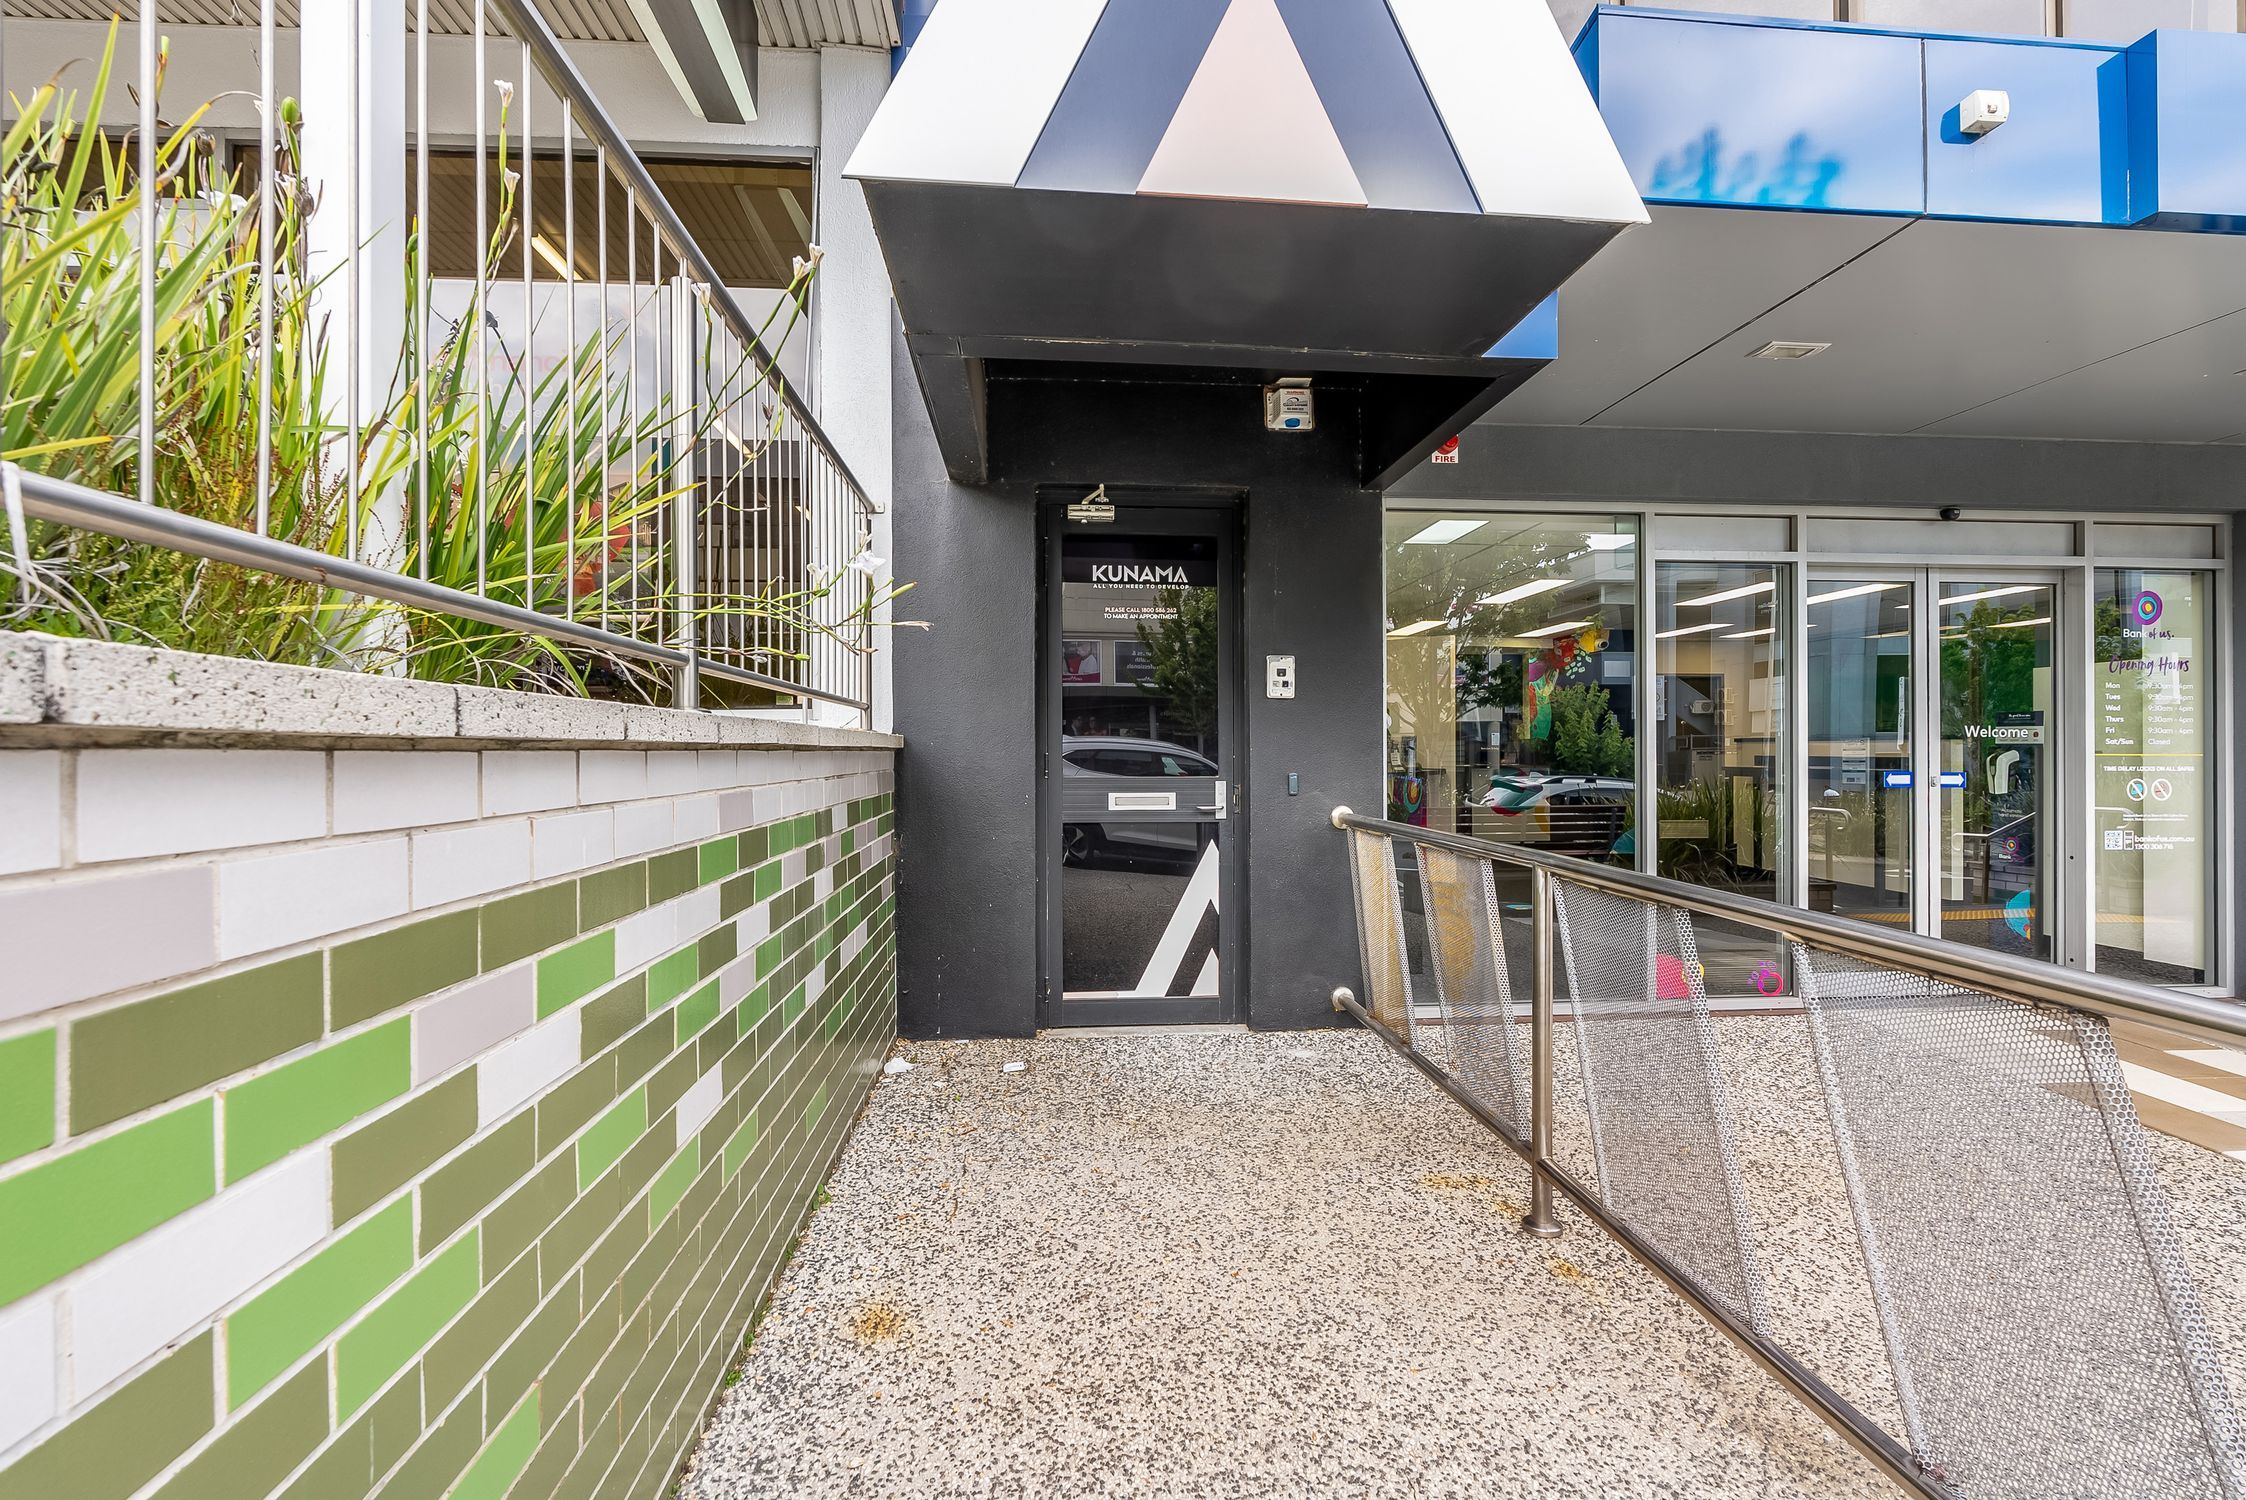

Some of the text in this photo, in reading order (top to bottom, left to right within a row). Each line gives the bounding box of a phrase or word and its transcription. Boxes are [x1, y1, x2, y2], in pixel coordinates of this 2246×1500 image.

[1435, 455, 1456, 463] FIRE
[1092, 565, 1189, 583] KUNAMA
[2123, 628, 2146, 638] Bank
[2148, 628, 2157, 639] of
[2109, 655, 2190, 677] Opening Hours
[2104, 715, 2124, 723] Thurs
[1964, 725, 2029, 738] Welcome
[2105, 738, 2134, 746] Sat/Sun
